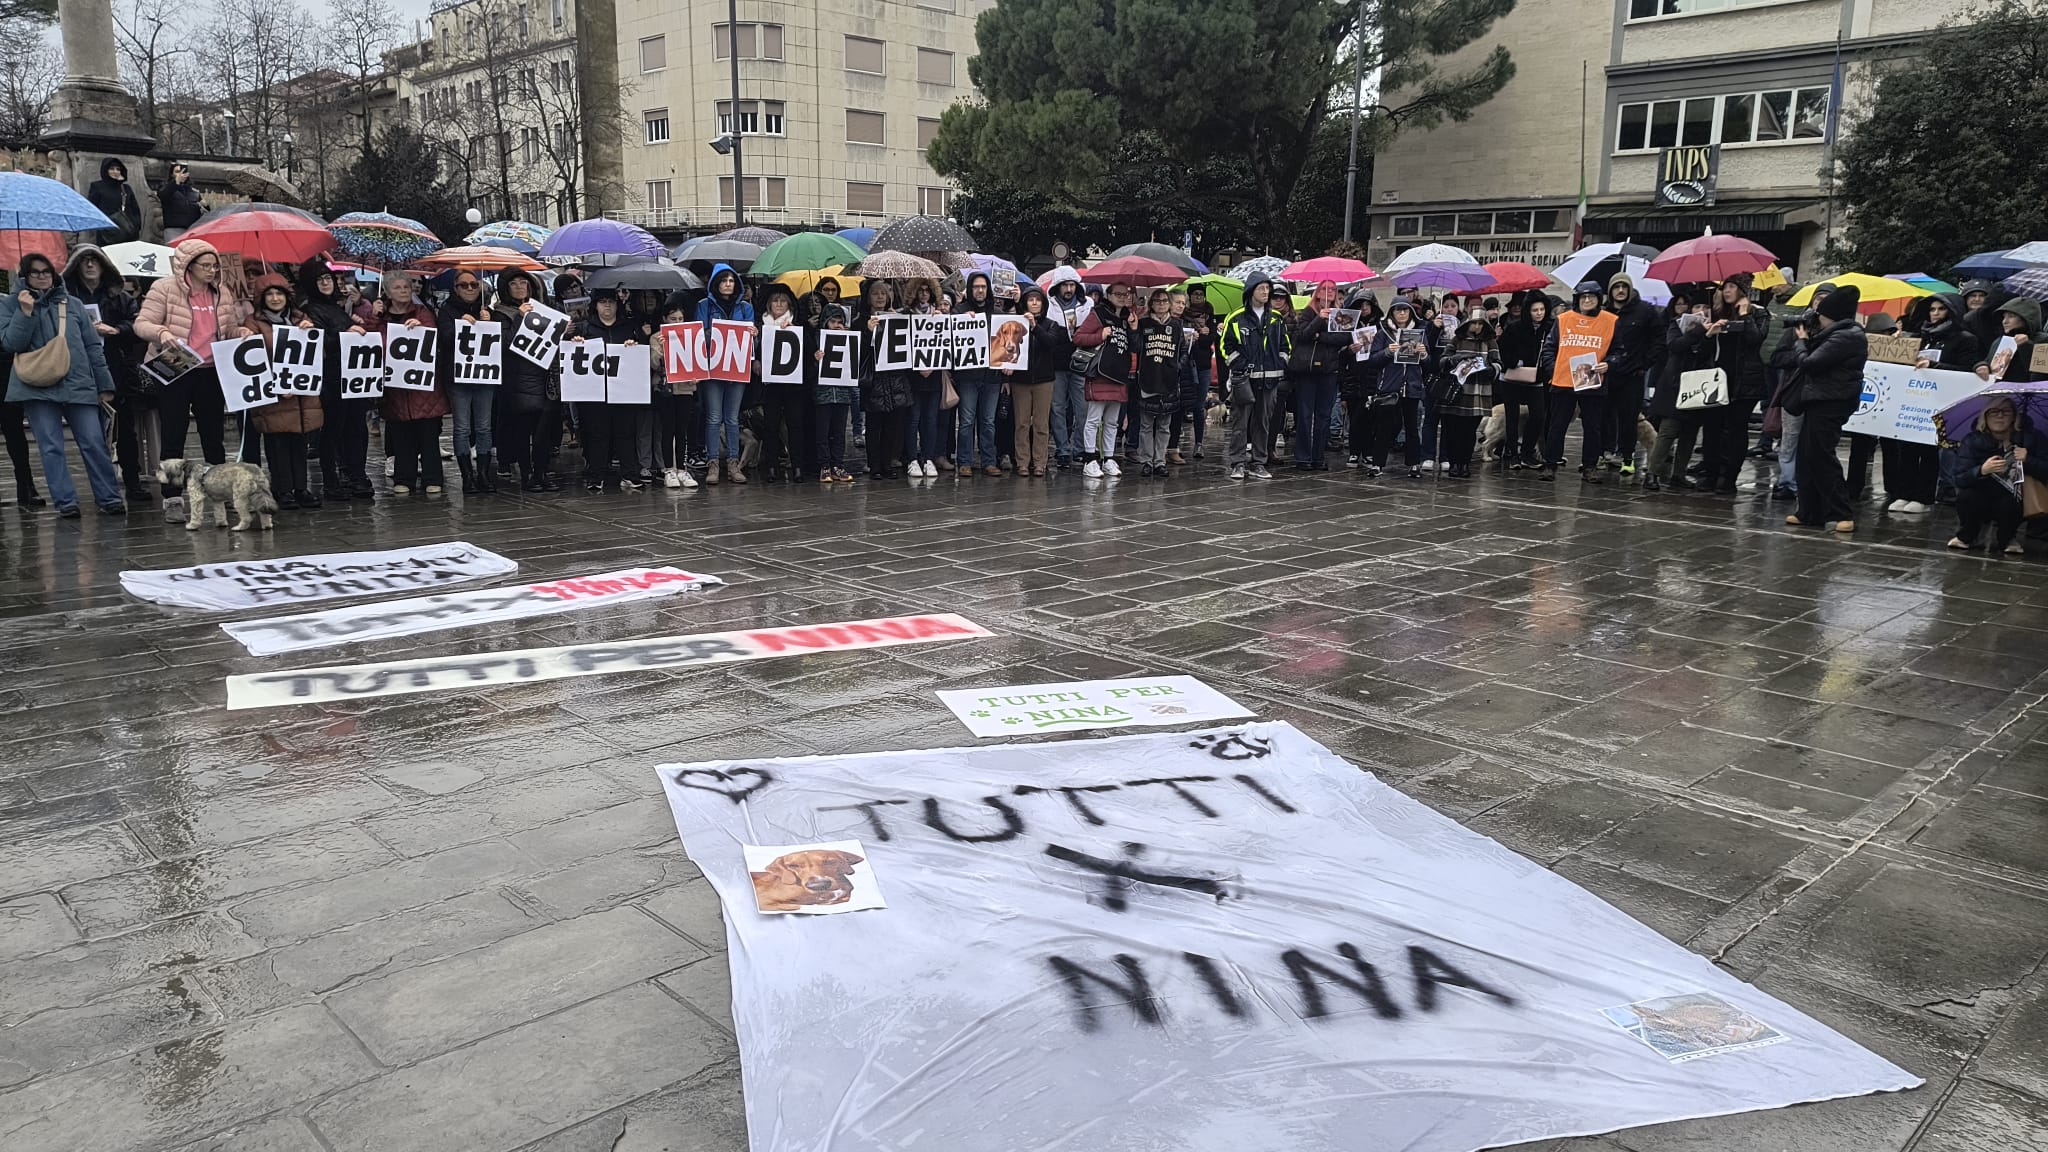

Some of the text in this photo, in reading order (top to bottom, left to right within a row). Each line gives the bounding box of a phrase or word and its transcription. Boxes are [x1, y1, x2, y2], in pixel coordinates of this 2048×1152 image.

[1665, 147, 1710, 181] INPS
[1490, 241, 1538, 253] NAZIONALE
[914, 317, 986, 331] Vogliamo
[914, 335, 975, 348] indietro
[1568, 333, 1602, 343] DIRITTI
[668, 328, 751, 374] NON
[913, 346, 986, 368] NINA!
[1908, 379, 1938, 391] ENPA
[1901, 404, 1932, 415] Sezione
[250, 617, 971, 697] TUTTI PER NINA
[977, 684, 1185, 709] TUTTI PER
[1023, 704, 1130, 721] NINA
[816, 774, 1298, 843] TUTTI
[1048, 942, 1520, 1032] NINA
